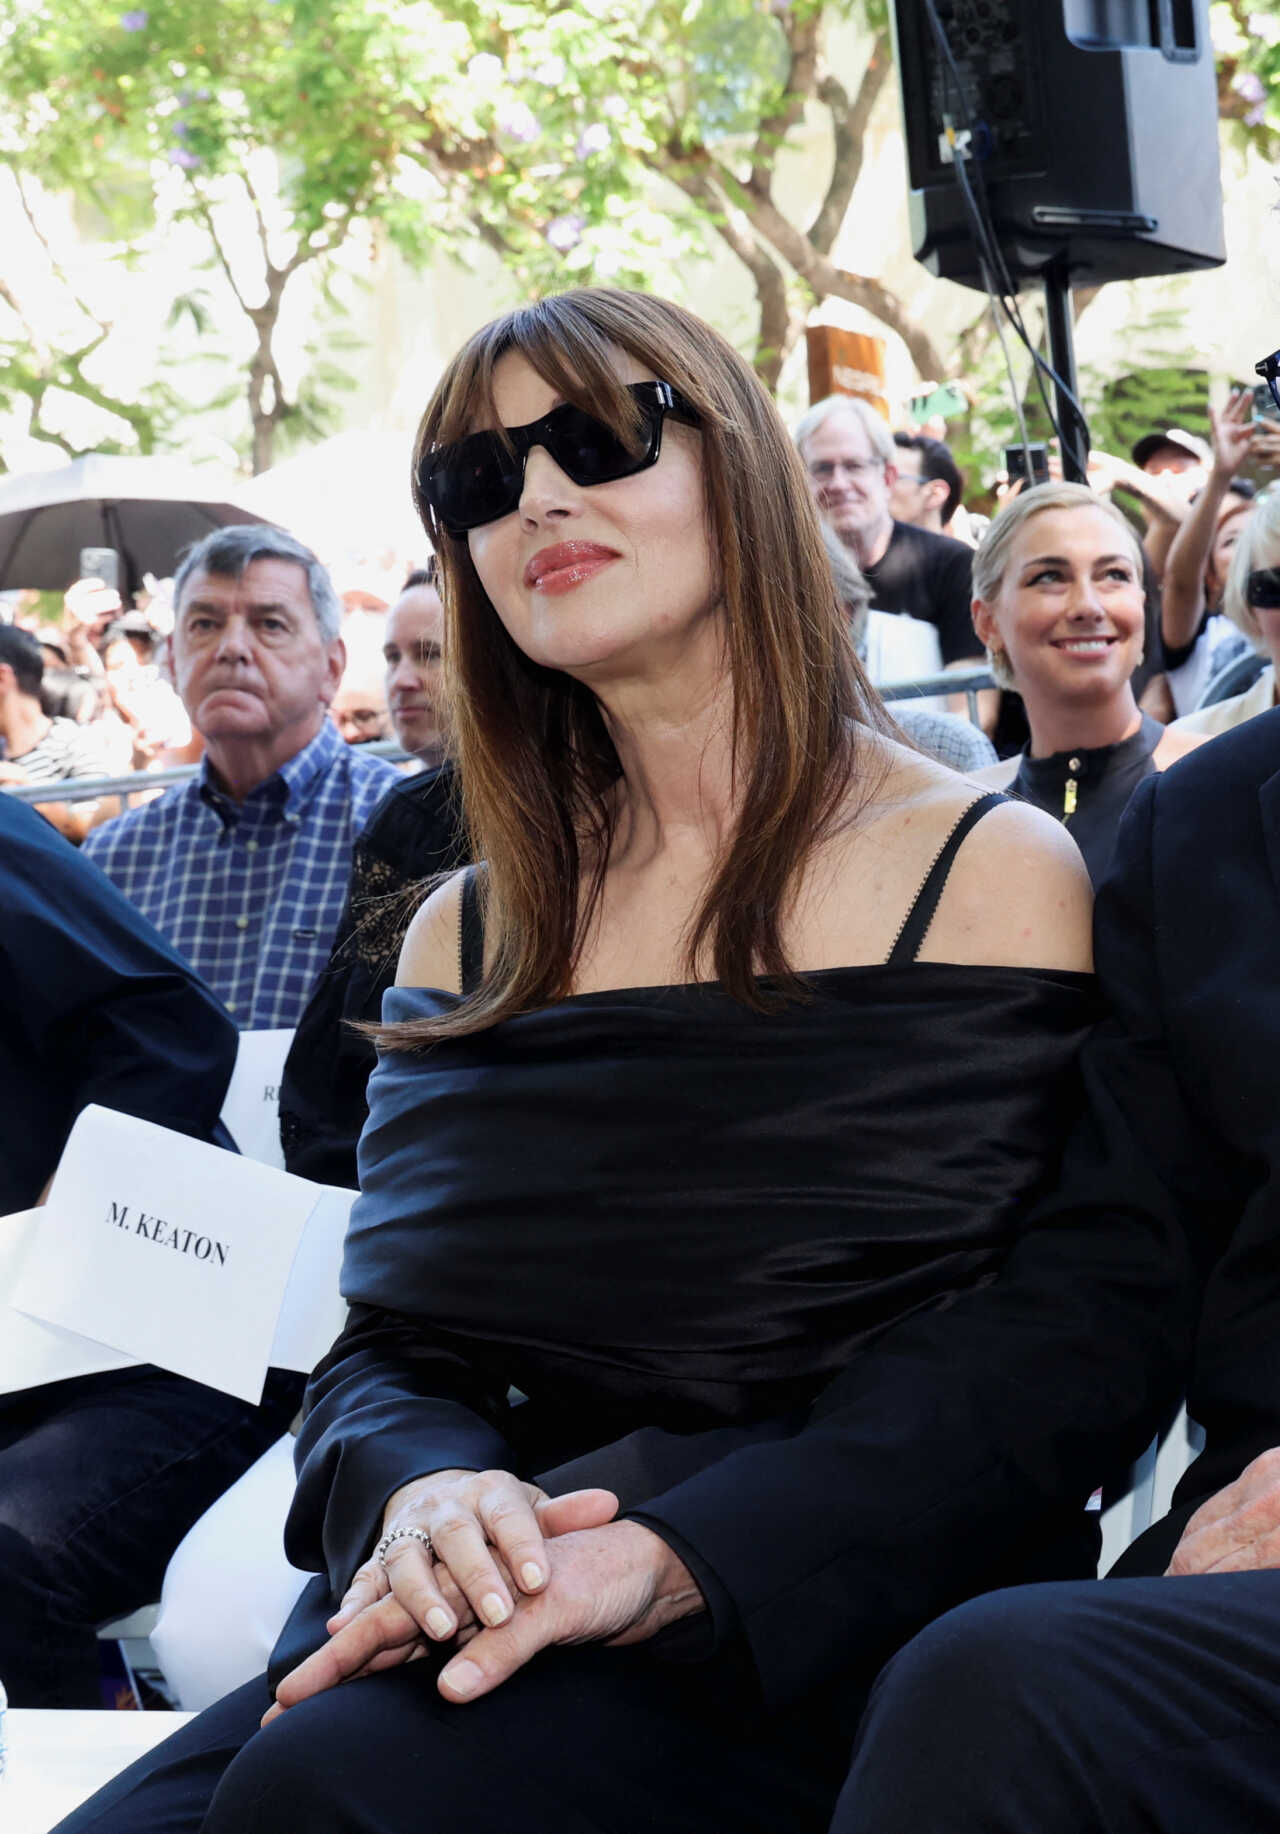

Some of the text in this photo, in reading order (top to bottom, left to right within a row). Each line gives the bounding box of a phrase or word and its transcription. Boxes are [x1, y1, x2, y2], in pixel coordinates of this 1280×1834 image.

[263, 1085, 280, 1101] R
[105, 1201, 230, 1266] M. KEATON
